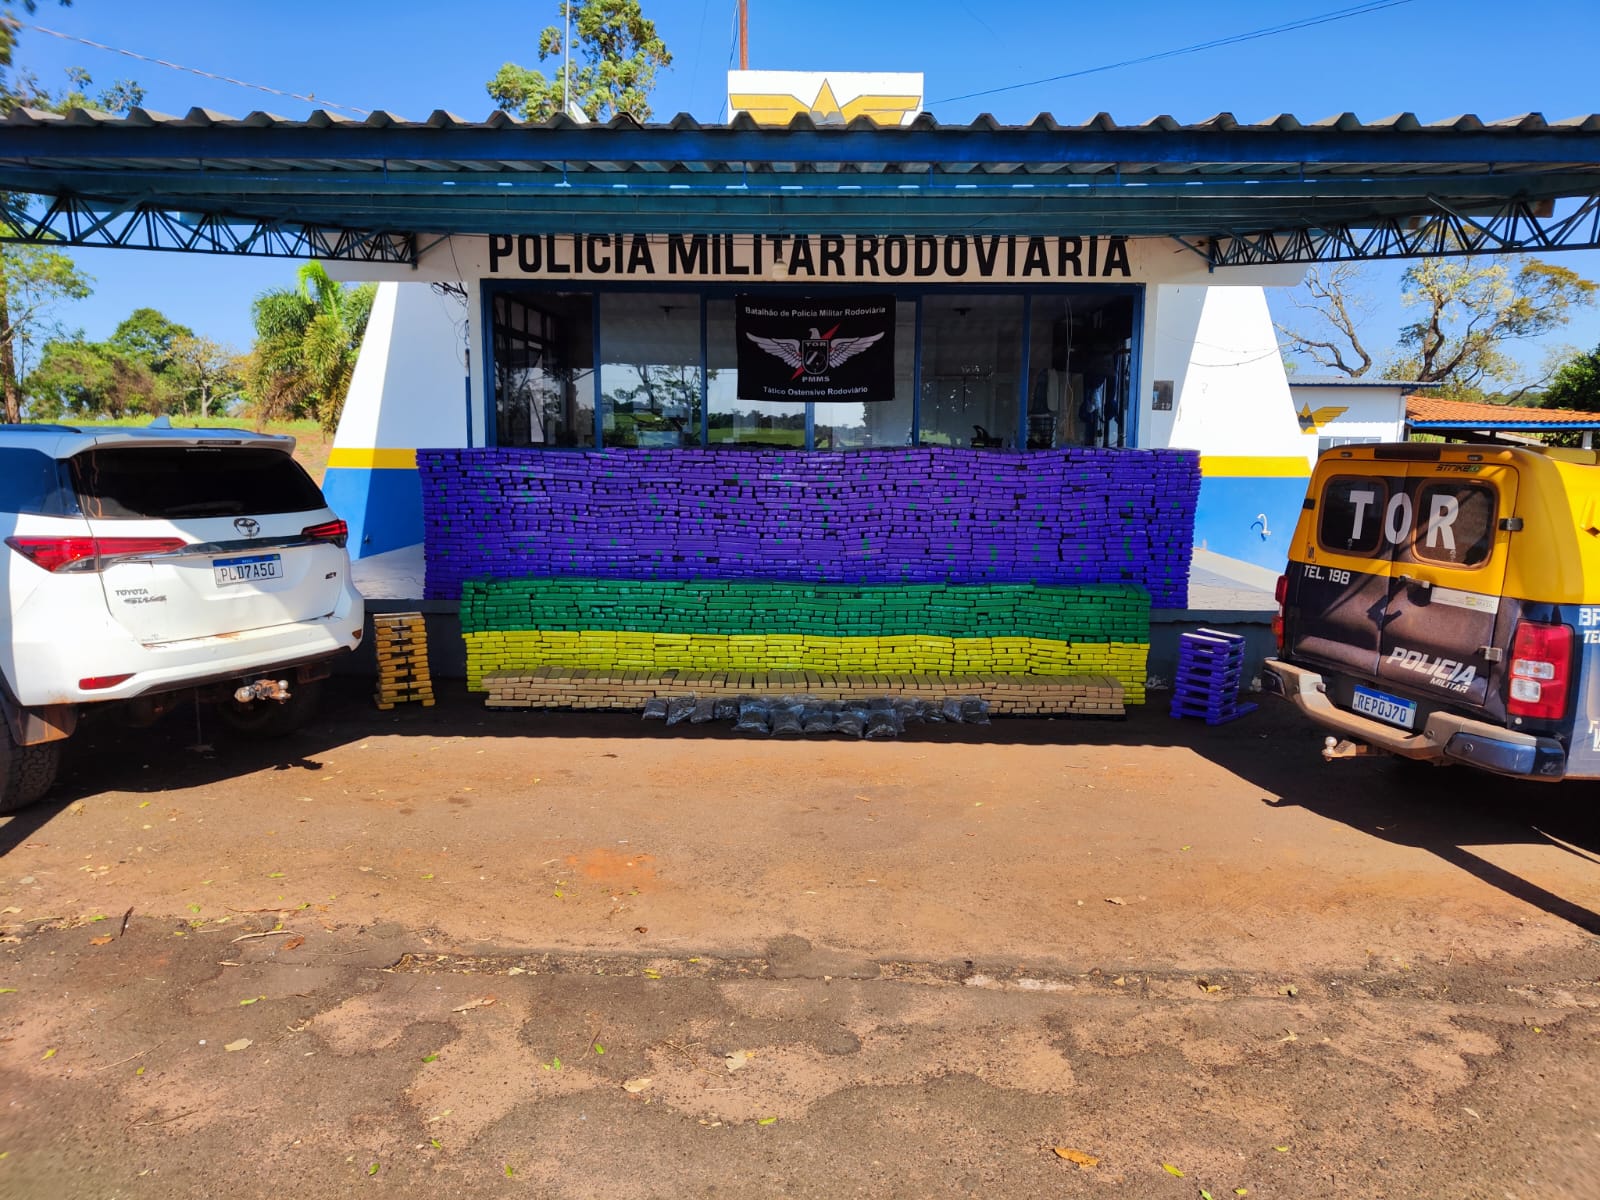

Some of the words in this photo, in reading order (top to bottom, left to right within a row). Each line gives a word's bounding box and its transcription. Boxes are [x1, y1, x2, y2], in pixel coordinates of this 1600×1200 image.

[489, 233, 655, 273] POLICIA
[668, 233, 846, 275] MILITAR
[855, 235, 1131, 277] RODOVIARIA
[780, 309, 790, 317] de
[819, 309, 843, 317] Militar
[801, 375, 830, 383] PMMS
[763, 386, 786, 395] Tático
[787, 388, 826, 396] Ostensivo
[827, 386, 868, 395] Rodoviário
[1349, 490, 1460, 550] TOR
[1304, 564, 1325, 580] TEL.
[1328, 568, 1351, 585] 198
[115, 588, 149, 596] TOYOTA
[1583, 630, 1600, 645] TE
[1386, 646, 1477, 686] POLICIA
[1429, 677, 1470, 694] MILITAR
